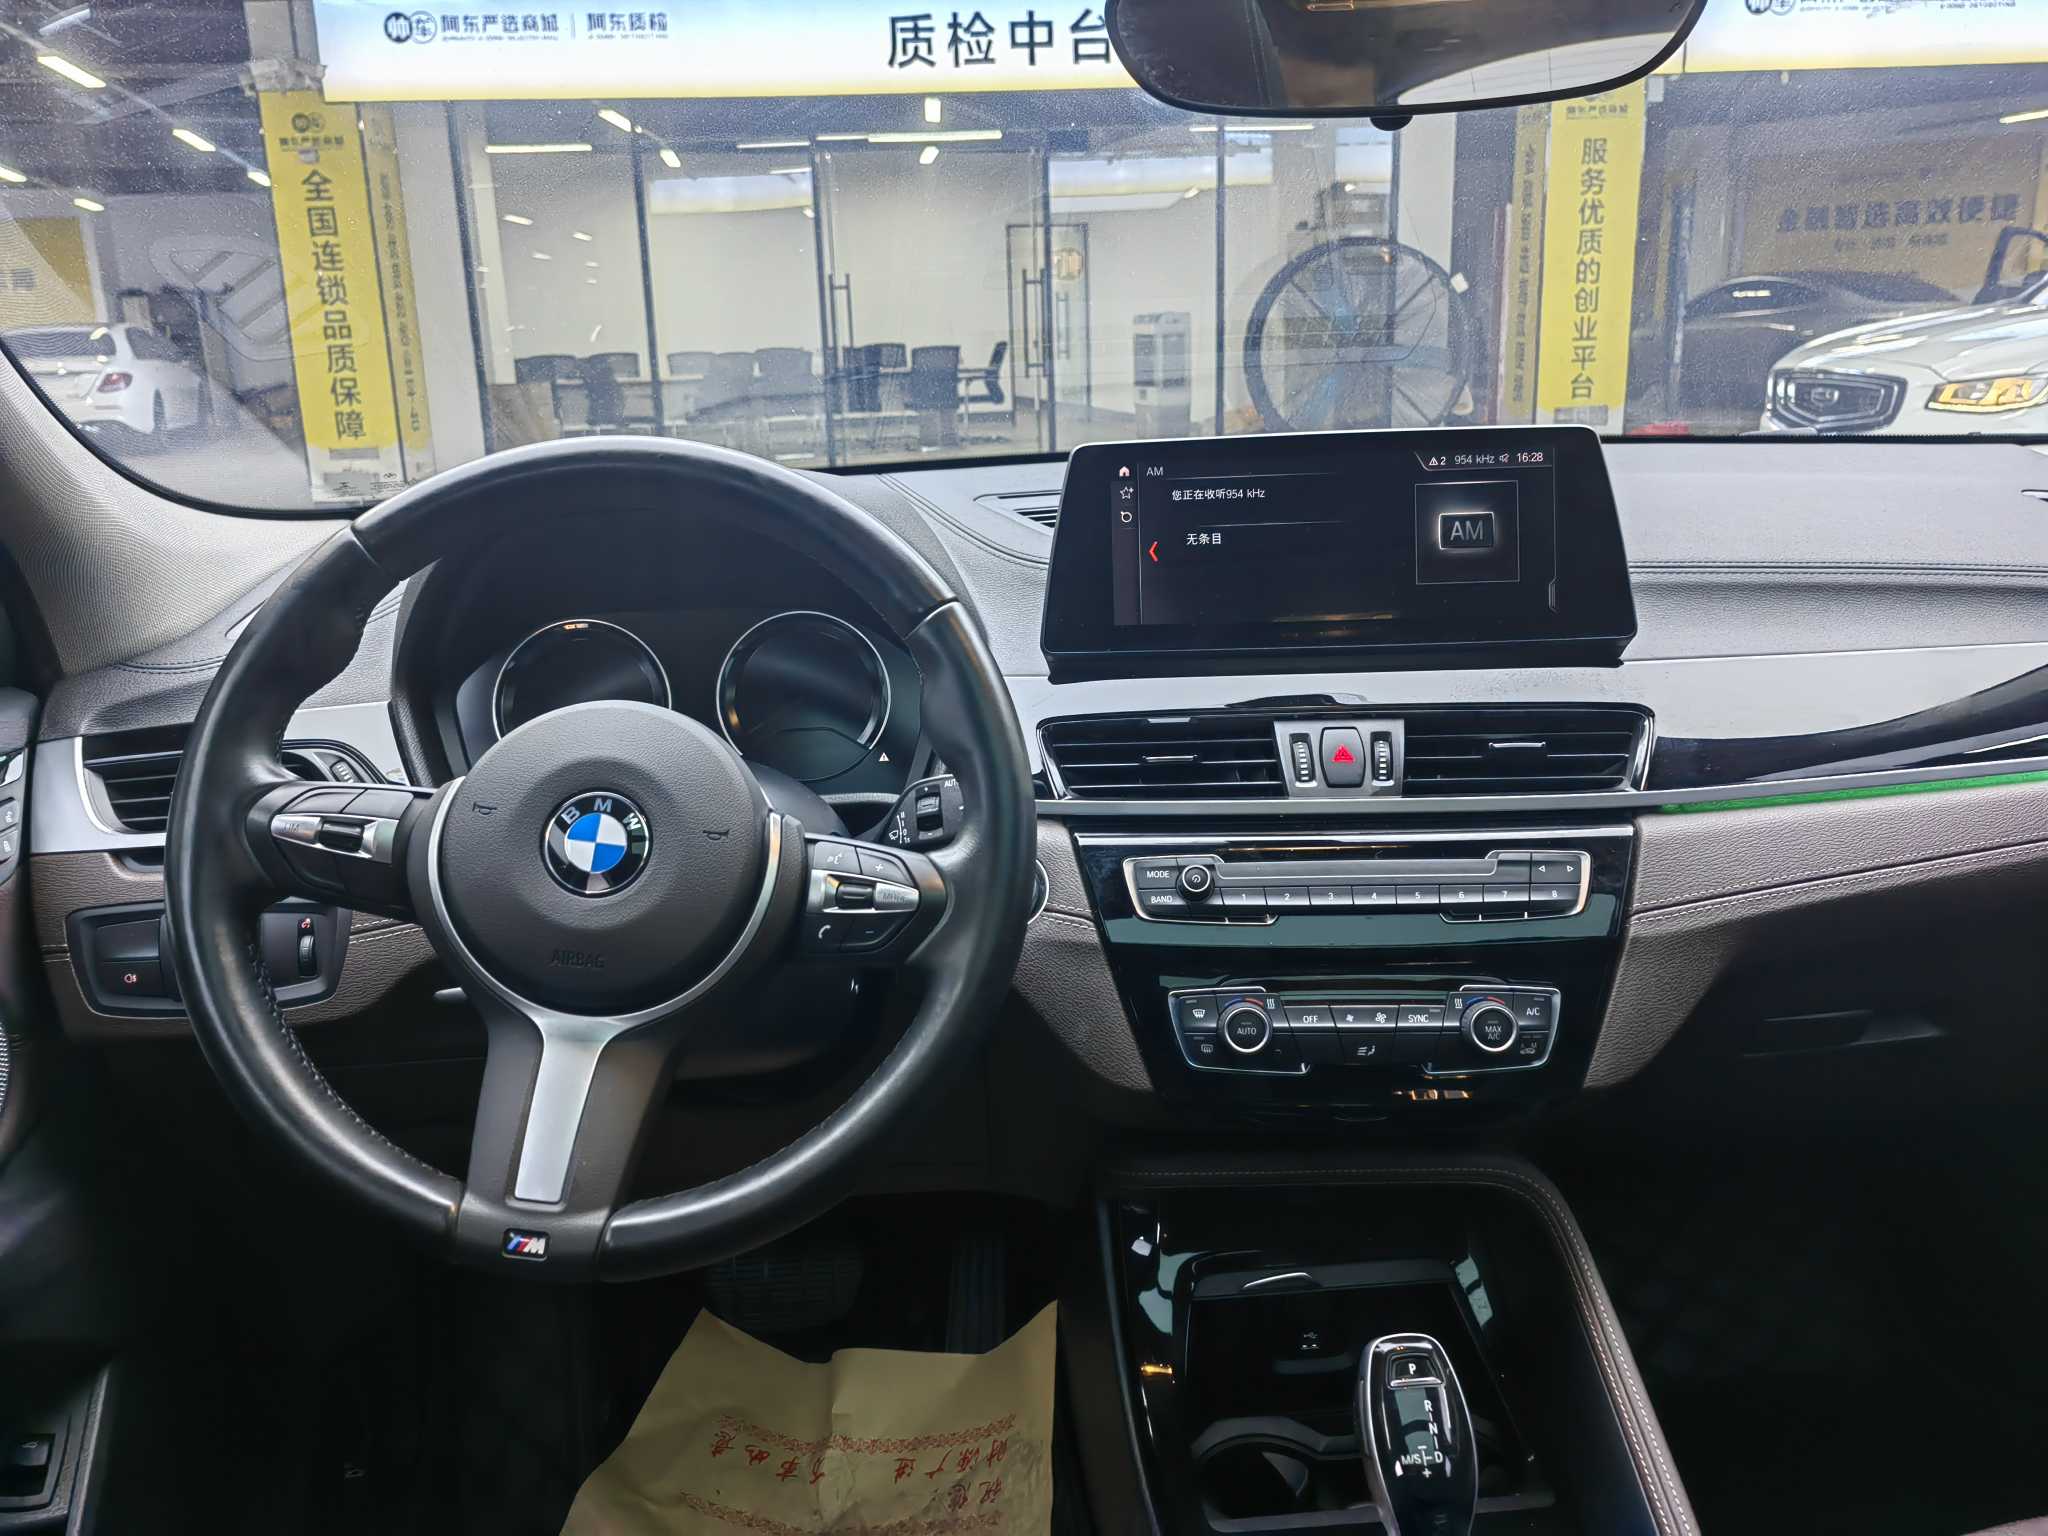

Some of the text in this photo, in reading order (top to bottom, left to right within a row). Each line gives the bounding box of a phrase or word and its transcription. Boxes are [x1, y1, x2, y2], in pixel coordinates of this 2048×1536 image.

[888, 8, 1111, 68] 质检中台
[1570, 137, 1608, 400] 服务优质的创业平台
[302, 169, 367, 441] 全国连锁品质保障
[1440, 452, 1543, 465] 2 954 kHz 16:28
[1146, 466, 1164, 476] AM
[1172, 488, 1266, 501] 您正在收听954 kHz
[1450, 520, 1484, 540] AM
[1186, 532, 1222, 545] 无条目
[561, 797, 642, 830] BMW
[1147, 870, 1170, 879] MODE
[1151, 895, 1173, 904] BAND
[1526, 1007, 1540, 1016] A/C
[1303, 1015, 1318, 1024] OFF
[1408, 1014, 1429, 1023] SYNC
[1237, 1027, 1257, 1036] AUTO
[1408, 1363, 1417, 1375] P
[1424, 1400, 1433, 1412] R
[1428, 1422, 1438, 1434] N
[1401, 1451, 1443, 1465] M/S D
